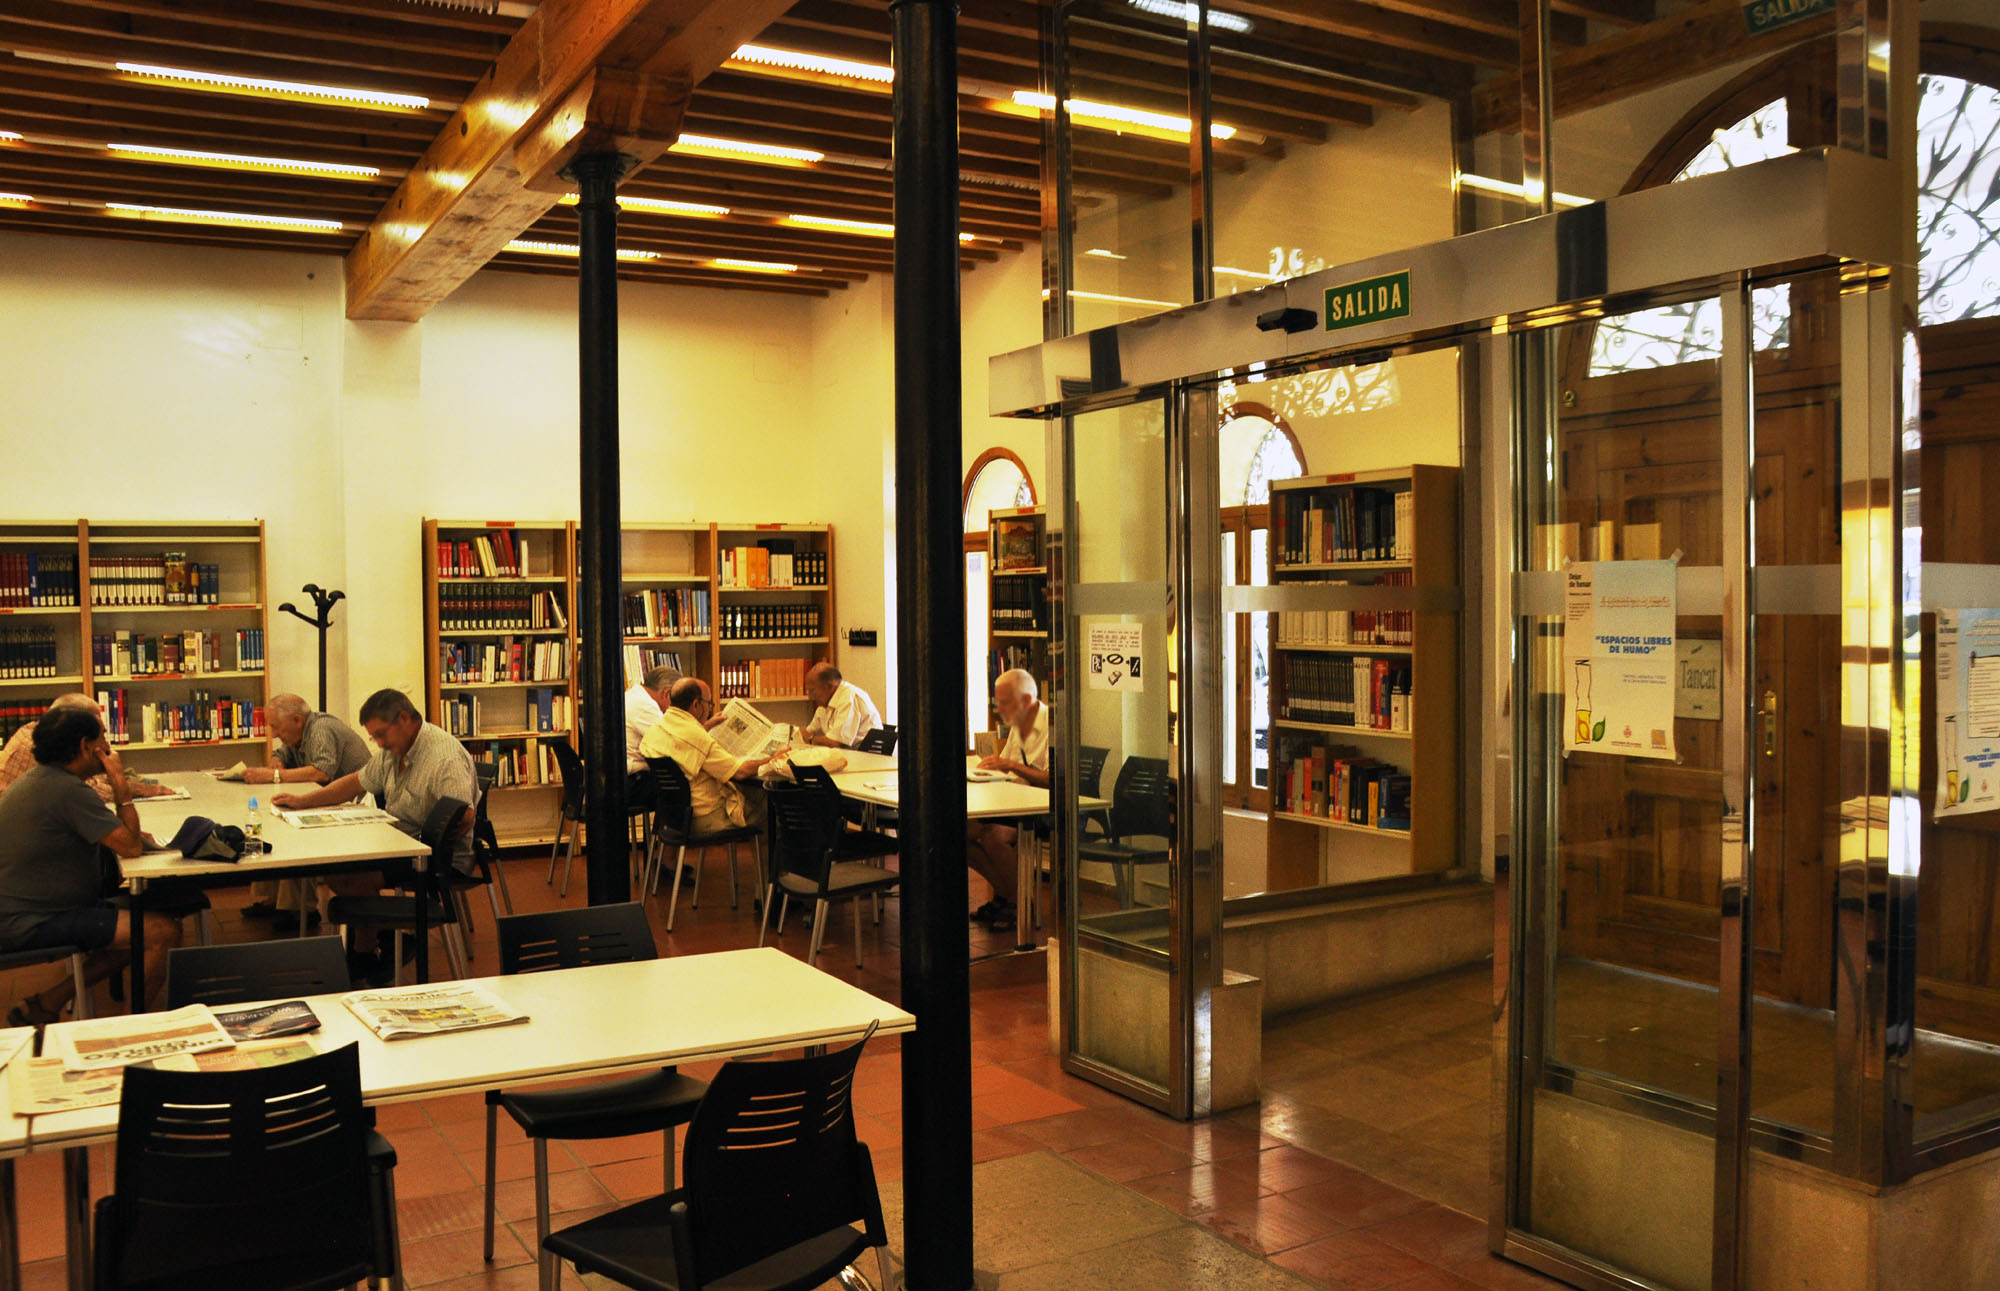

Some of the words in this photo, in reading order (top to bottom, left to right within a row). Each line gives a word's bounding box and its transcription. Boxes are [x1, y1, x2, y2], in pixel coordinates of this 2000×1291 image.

[1332, 282, 1402, 321] SALIDA
[1609, 646, 1621, 654] DE
[1643, 637, 1672, 645] LIBRES
[1680, 660, 1717, 690] Tancat
